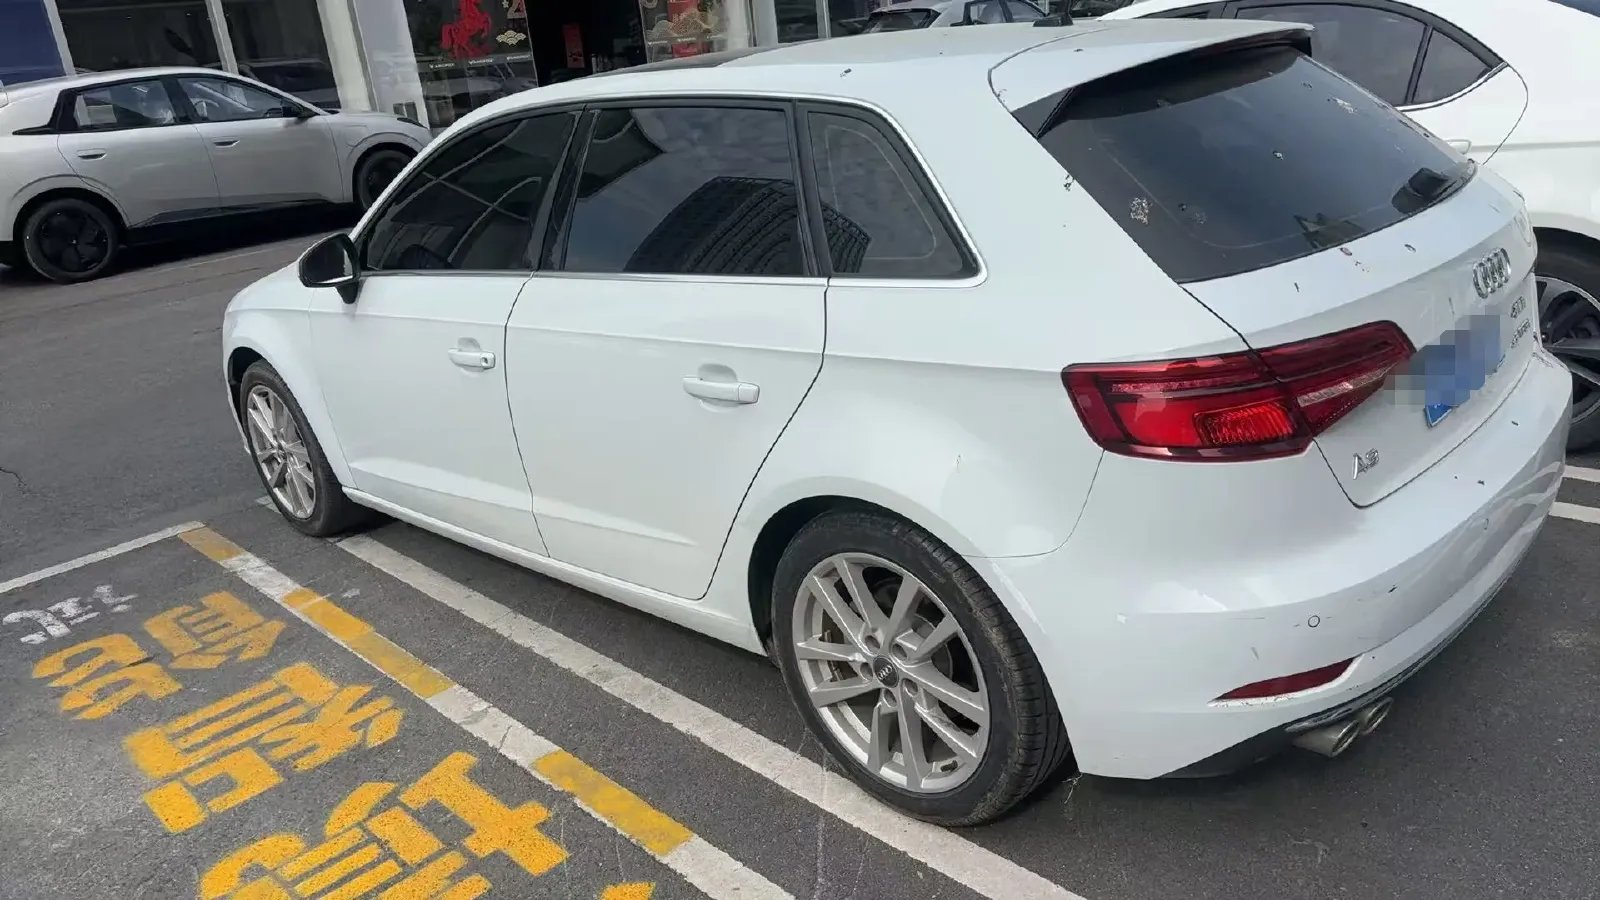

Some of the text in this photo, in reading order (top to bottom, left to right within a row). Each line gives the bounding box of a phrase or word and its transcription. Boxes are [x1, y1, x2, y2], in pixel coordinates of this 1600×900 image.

[1352, 448, 1381, 481] A3
[32, 592, 655, 900] 境智能
